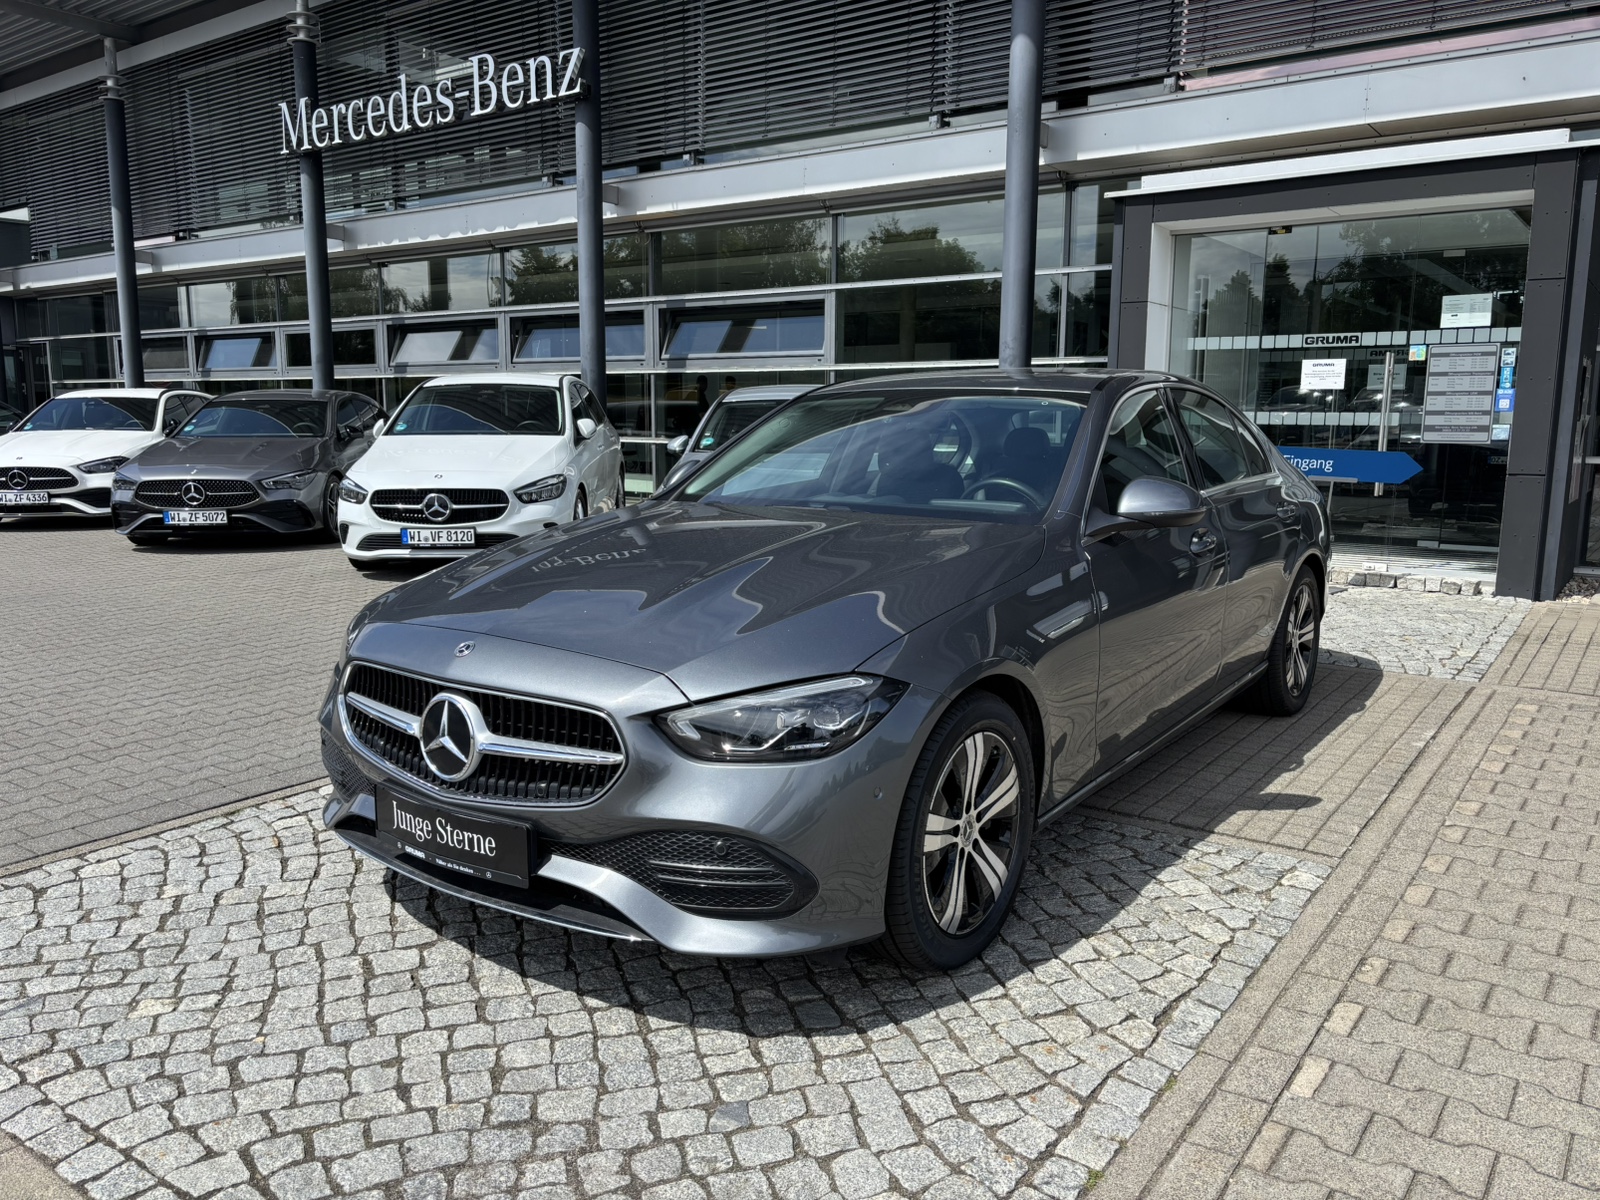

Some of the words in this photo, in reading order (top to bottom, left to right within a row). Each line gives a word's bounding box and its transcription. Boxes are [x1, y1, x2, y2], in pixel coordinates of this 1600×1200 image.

[278, 47, 586, 154] Mercedes-Benz
[1304, 335, 1360, 346] GRUMA
[14, 493, 24, 503] ZF
[26, 493, 47, 502] 4336
[170, 512, 182, 523] WI
[188, 512, 200, 523] ZF
[201, 512, 226, 522] 5072
[409, 530, 422, 542] WI
[430, 530, 444, 542] VF
[446, 530, 473, 542] 8120
[392, 800, 432, 842] Junge
[436, 817, 496, 856] Sterne
[914, 861, 934, 940] MICHELIN
